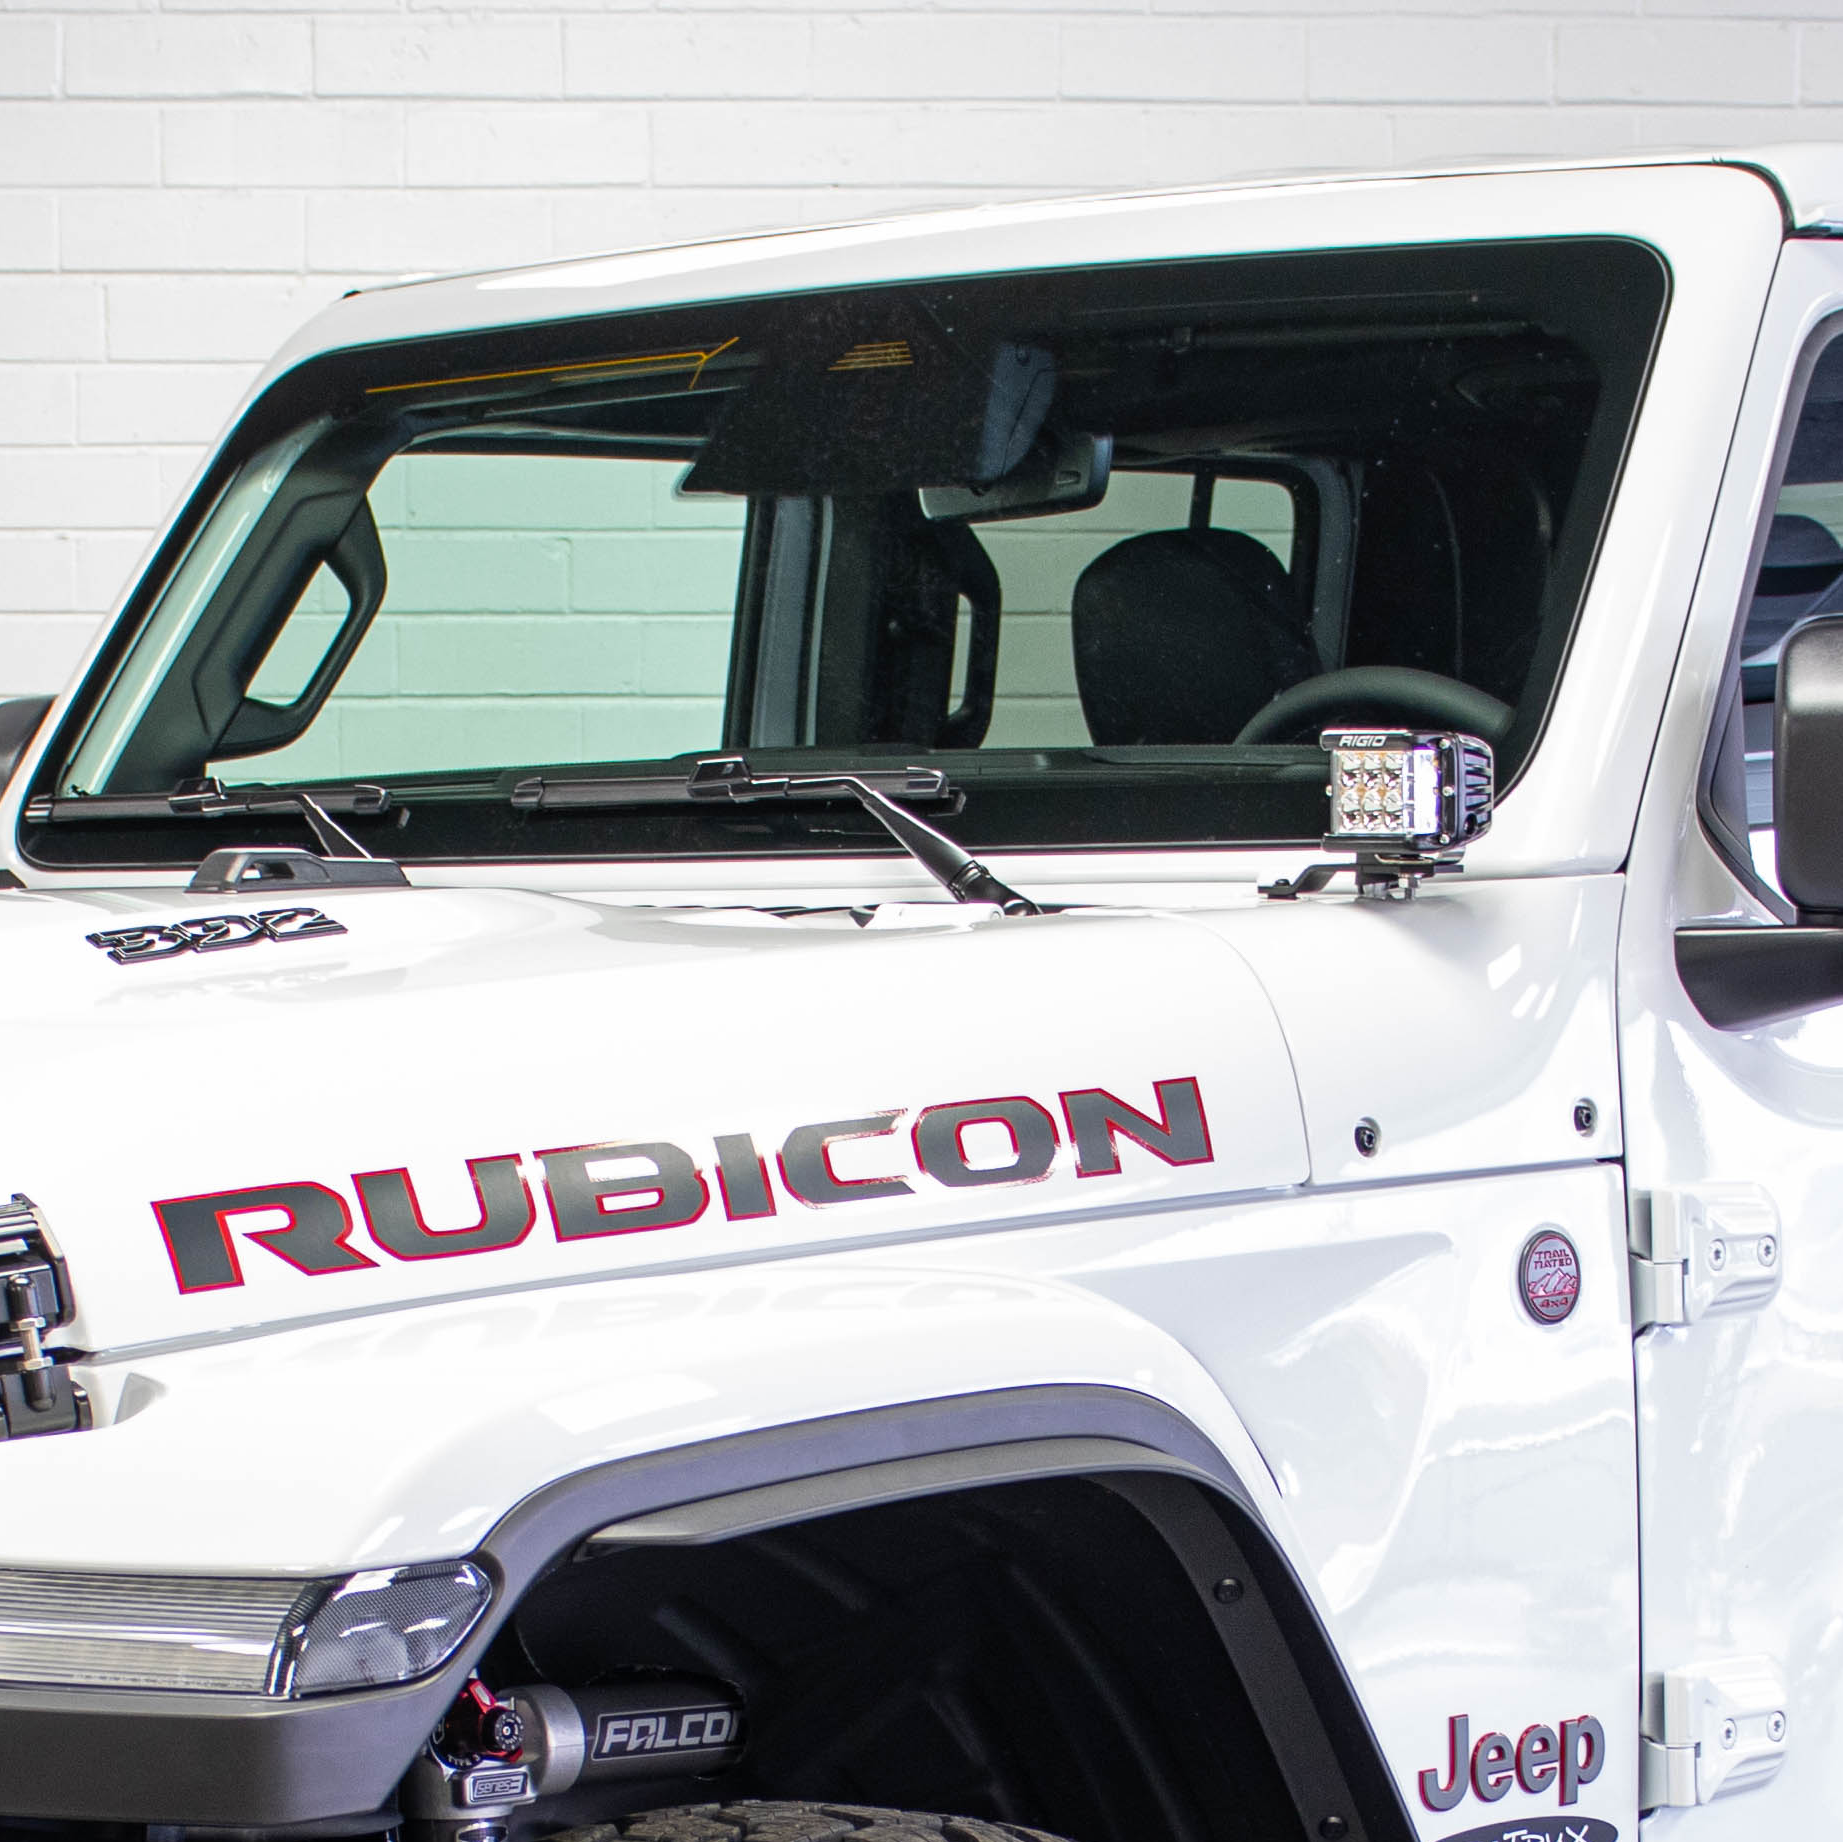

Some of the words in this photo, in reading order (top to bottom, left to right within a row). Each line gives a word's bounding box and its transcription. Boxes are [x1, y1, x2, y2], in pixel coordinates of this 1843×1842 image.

[1337, 734, 1388, 748] RIGID
[84, 906, 349, 966] 392
[151, 1073, 1216, 1297] RUBICON
[1533, 1257, 1572, 1270] RATED
[1535, 1248, 1570, 1260] TRAIL
[1417, 1713, 1606, 1813] Jeep
